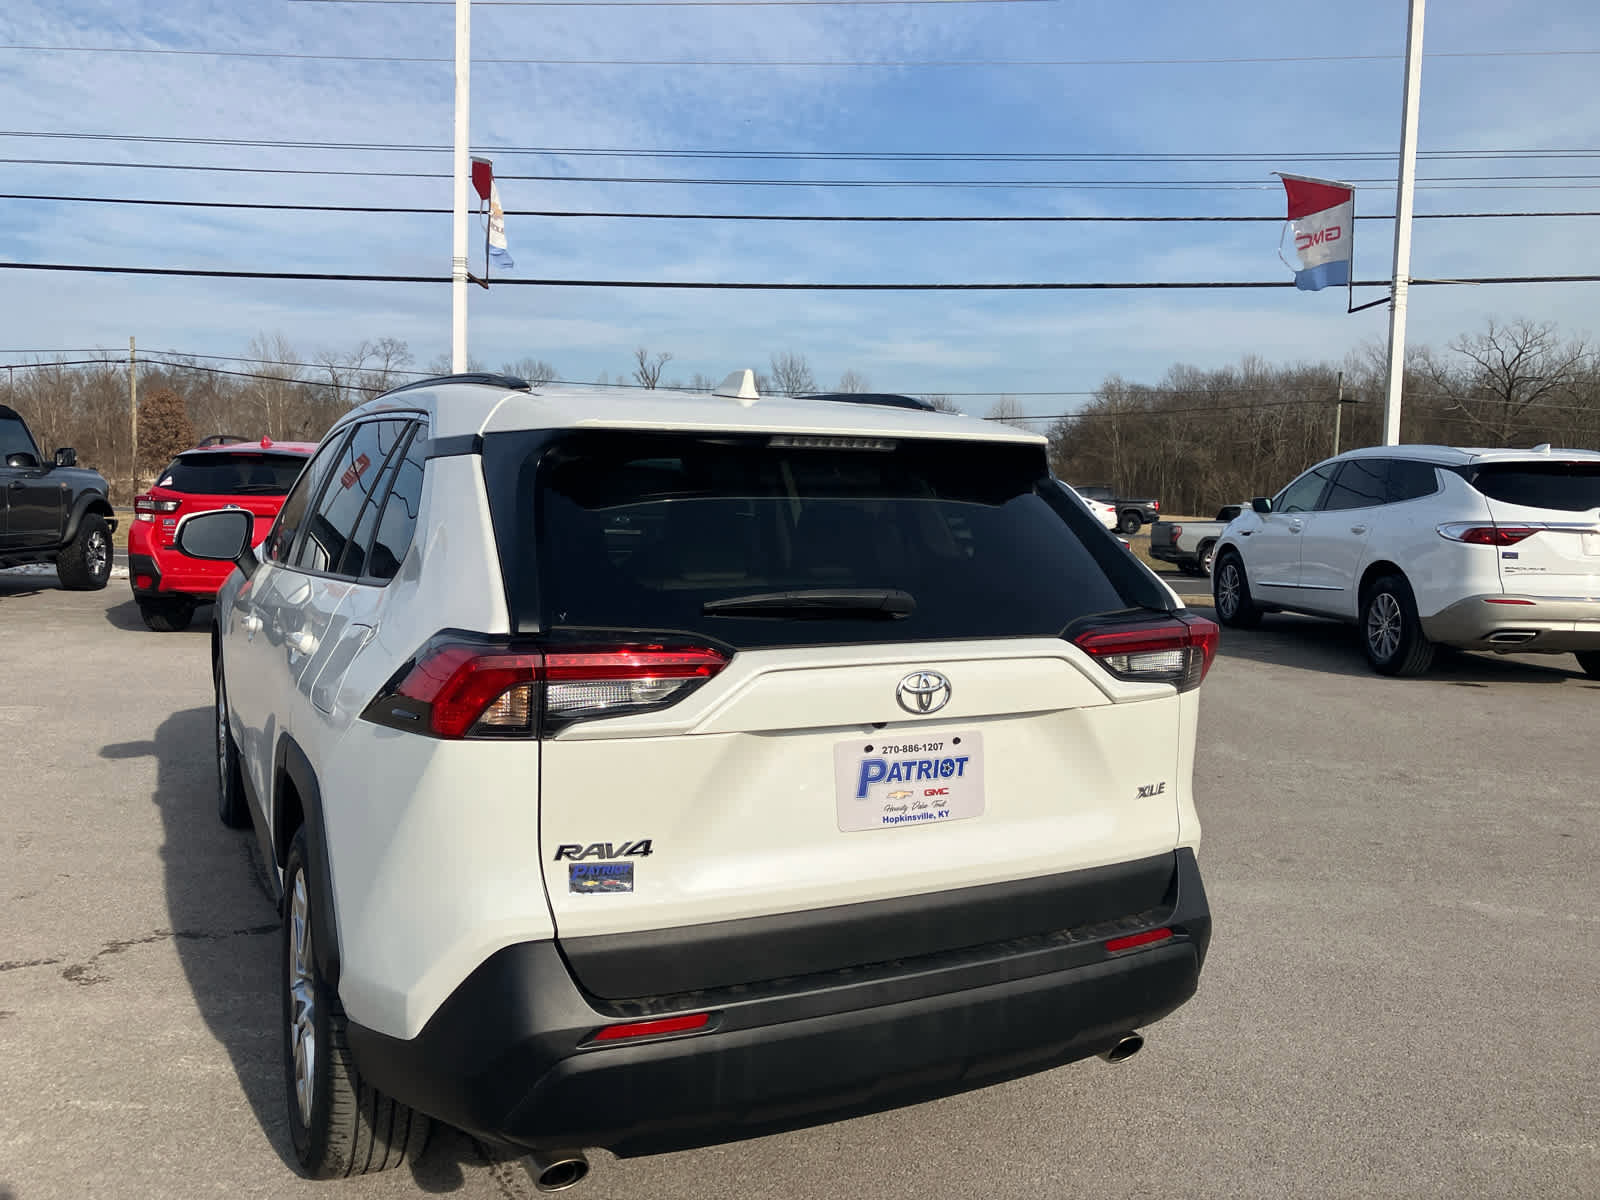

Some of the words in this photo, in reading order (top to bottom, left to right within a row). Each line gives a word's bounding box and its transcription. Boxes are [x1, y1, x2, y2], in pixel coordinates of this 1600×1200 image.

[882, 743, 944, 755] 270-886-1207
[856, 757, 969, 798] PATRIOT
[924, 788, 949, 796] GMC
[1136, 782, 1166, 799] XLE
[882, 812, 936, 824] Hopkinsville,
[938, 810, 950, 818] KY
[554, 839, 653, 861] RAV4
